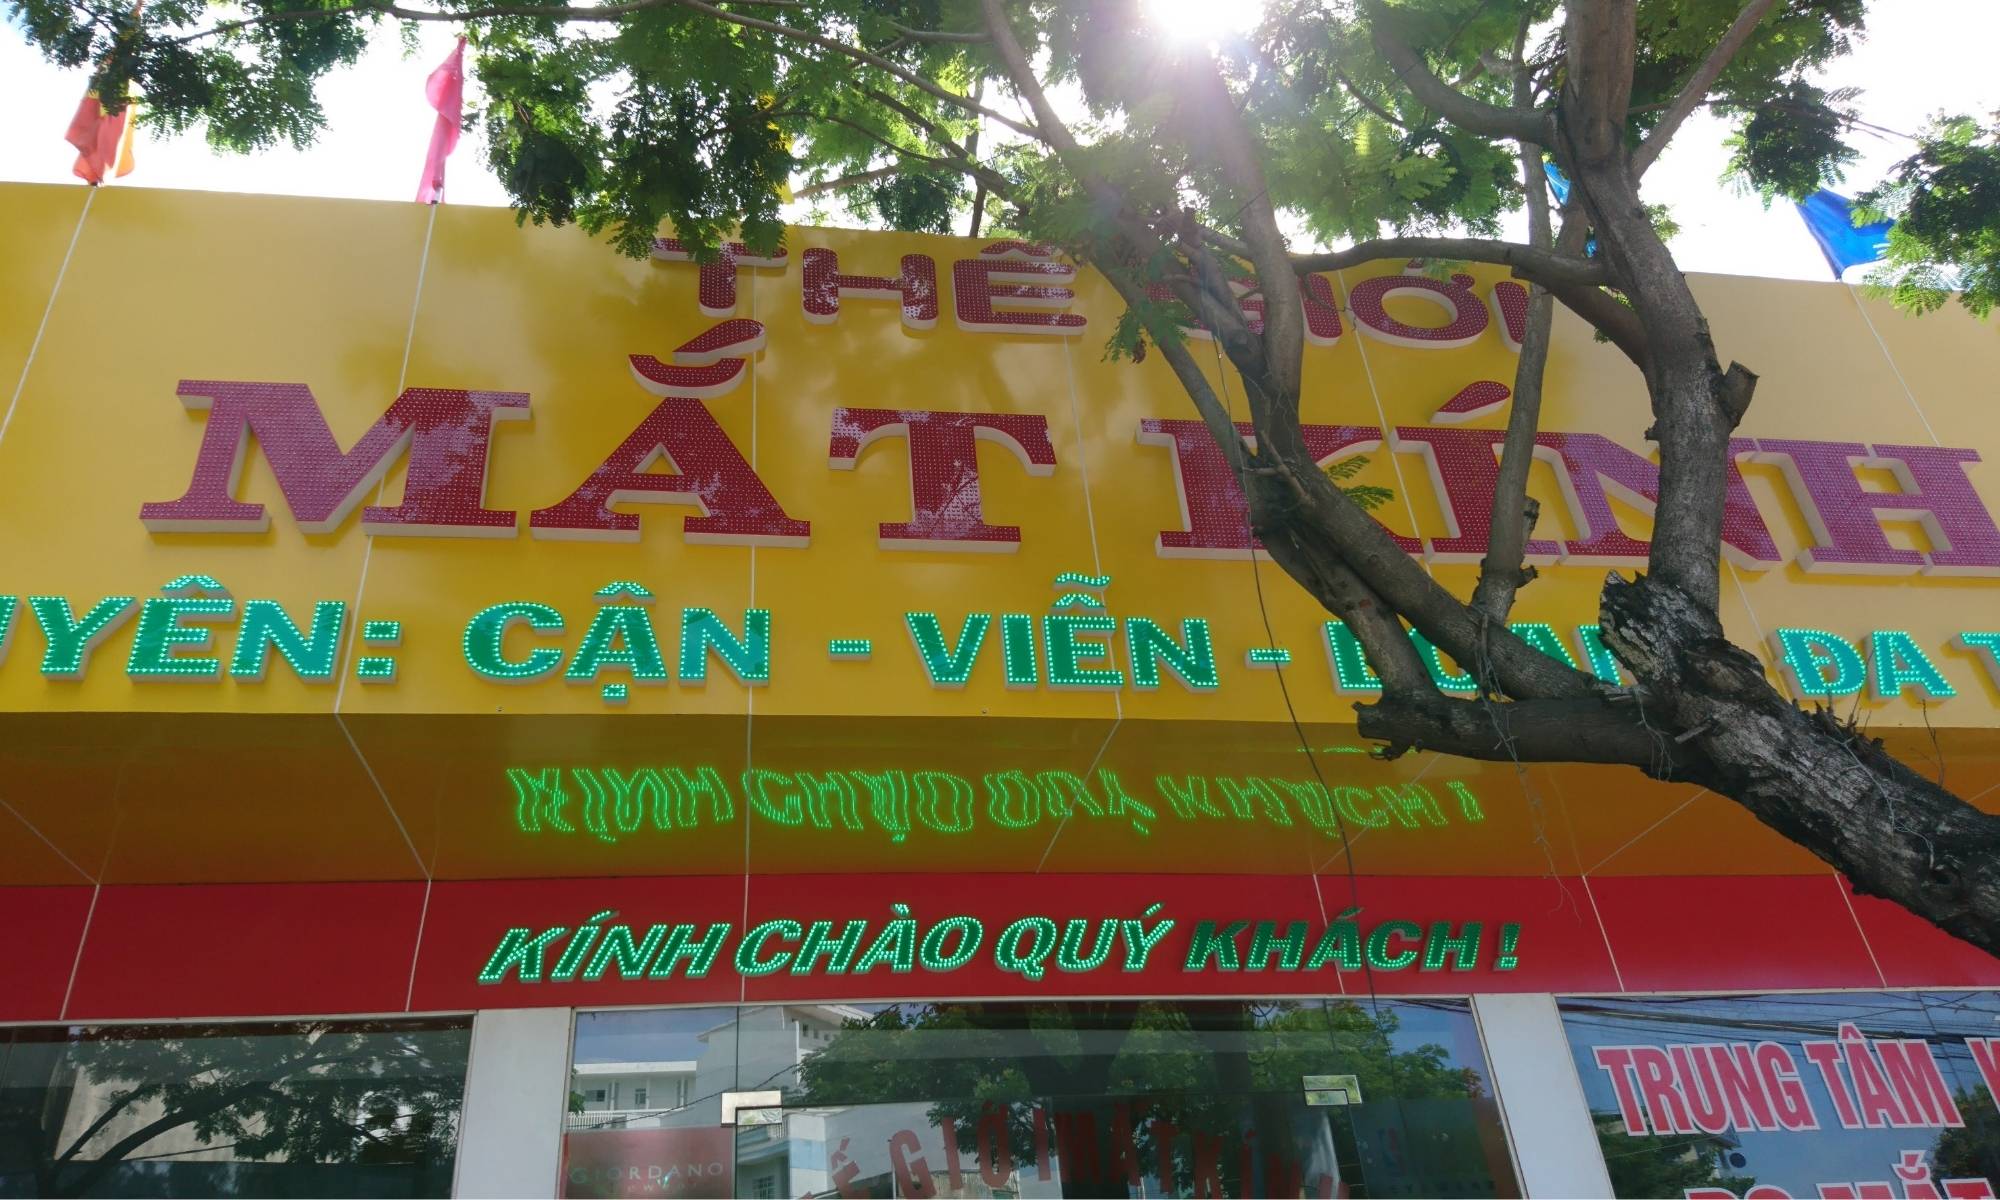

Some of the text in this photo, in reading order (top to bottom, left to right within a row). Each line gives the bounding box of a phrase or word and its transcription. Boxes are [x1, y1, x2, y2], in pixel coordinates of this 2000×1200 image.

[139, 318, 2000, 578] MẮT KÍNH
[0, 574, 400, 683] YÊN:
[461, 580, 771, 703] CẬN
[829, 638, 872, 661] -
[905, 572, 1220, 692] VIỄN
[1246, 648, 1292, 668] -
[1768, 627, 1958, 700] ĐA
[477, 902, 1522, 984] KÍNH CHÀO QUÝ KHÁCH !
[1592, 1040, 1821, 1137] TRUNG
[1801, 1022, 1967, 1130] TÂM
